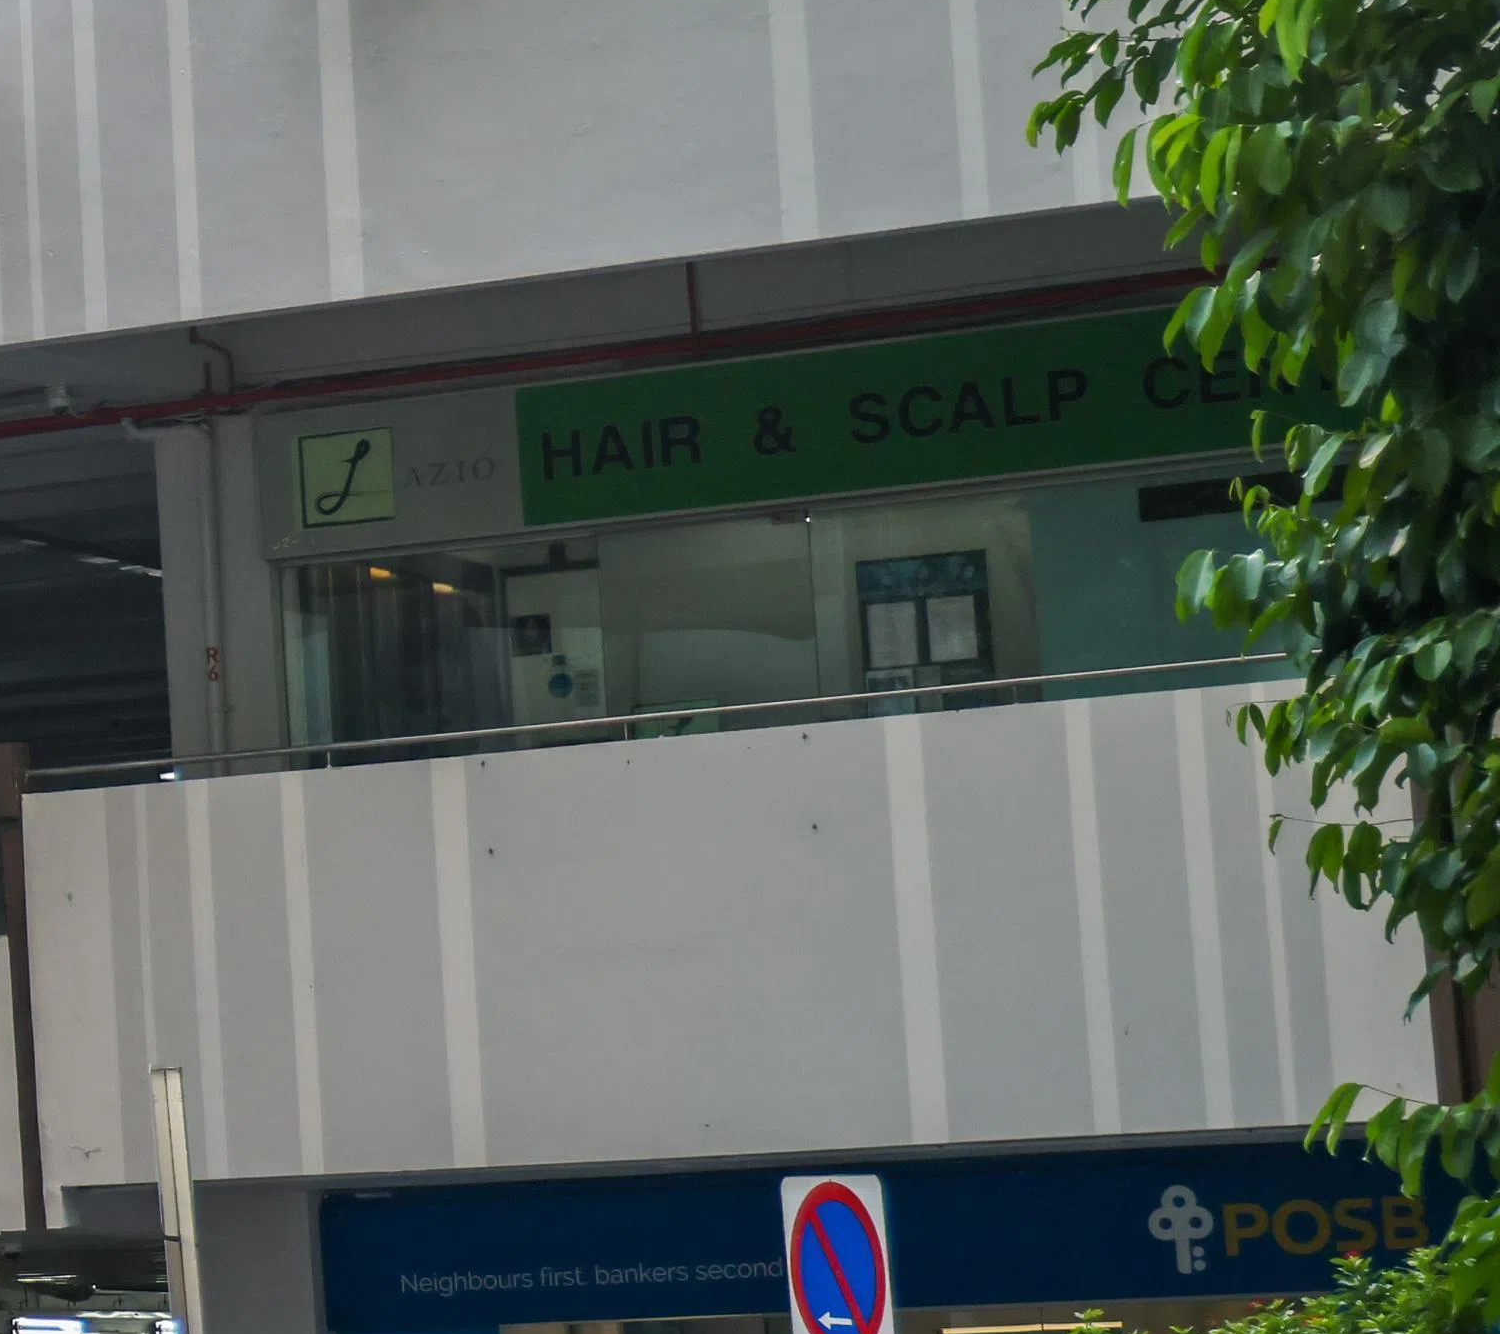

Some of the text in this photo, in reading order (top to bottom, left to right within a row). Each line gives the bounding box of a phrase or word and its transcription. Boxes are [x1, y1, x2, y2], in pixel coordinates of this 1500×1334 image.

[541, 413, 702, 482] HAIR
[752, 405, 795, 456] &
[849, 368, 1088, 447] SCALP
[1221, 1196, 1430, 1257] POSB
[401, 1270, 534, 1298] Neighbours
[595, 1261, 688, 1285] bankers
[695, 1257, 784, 1280] second
